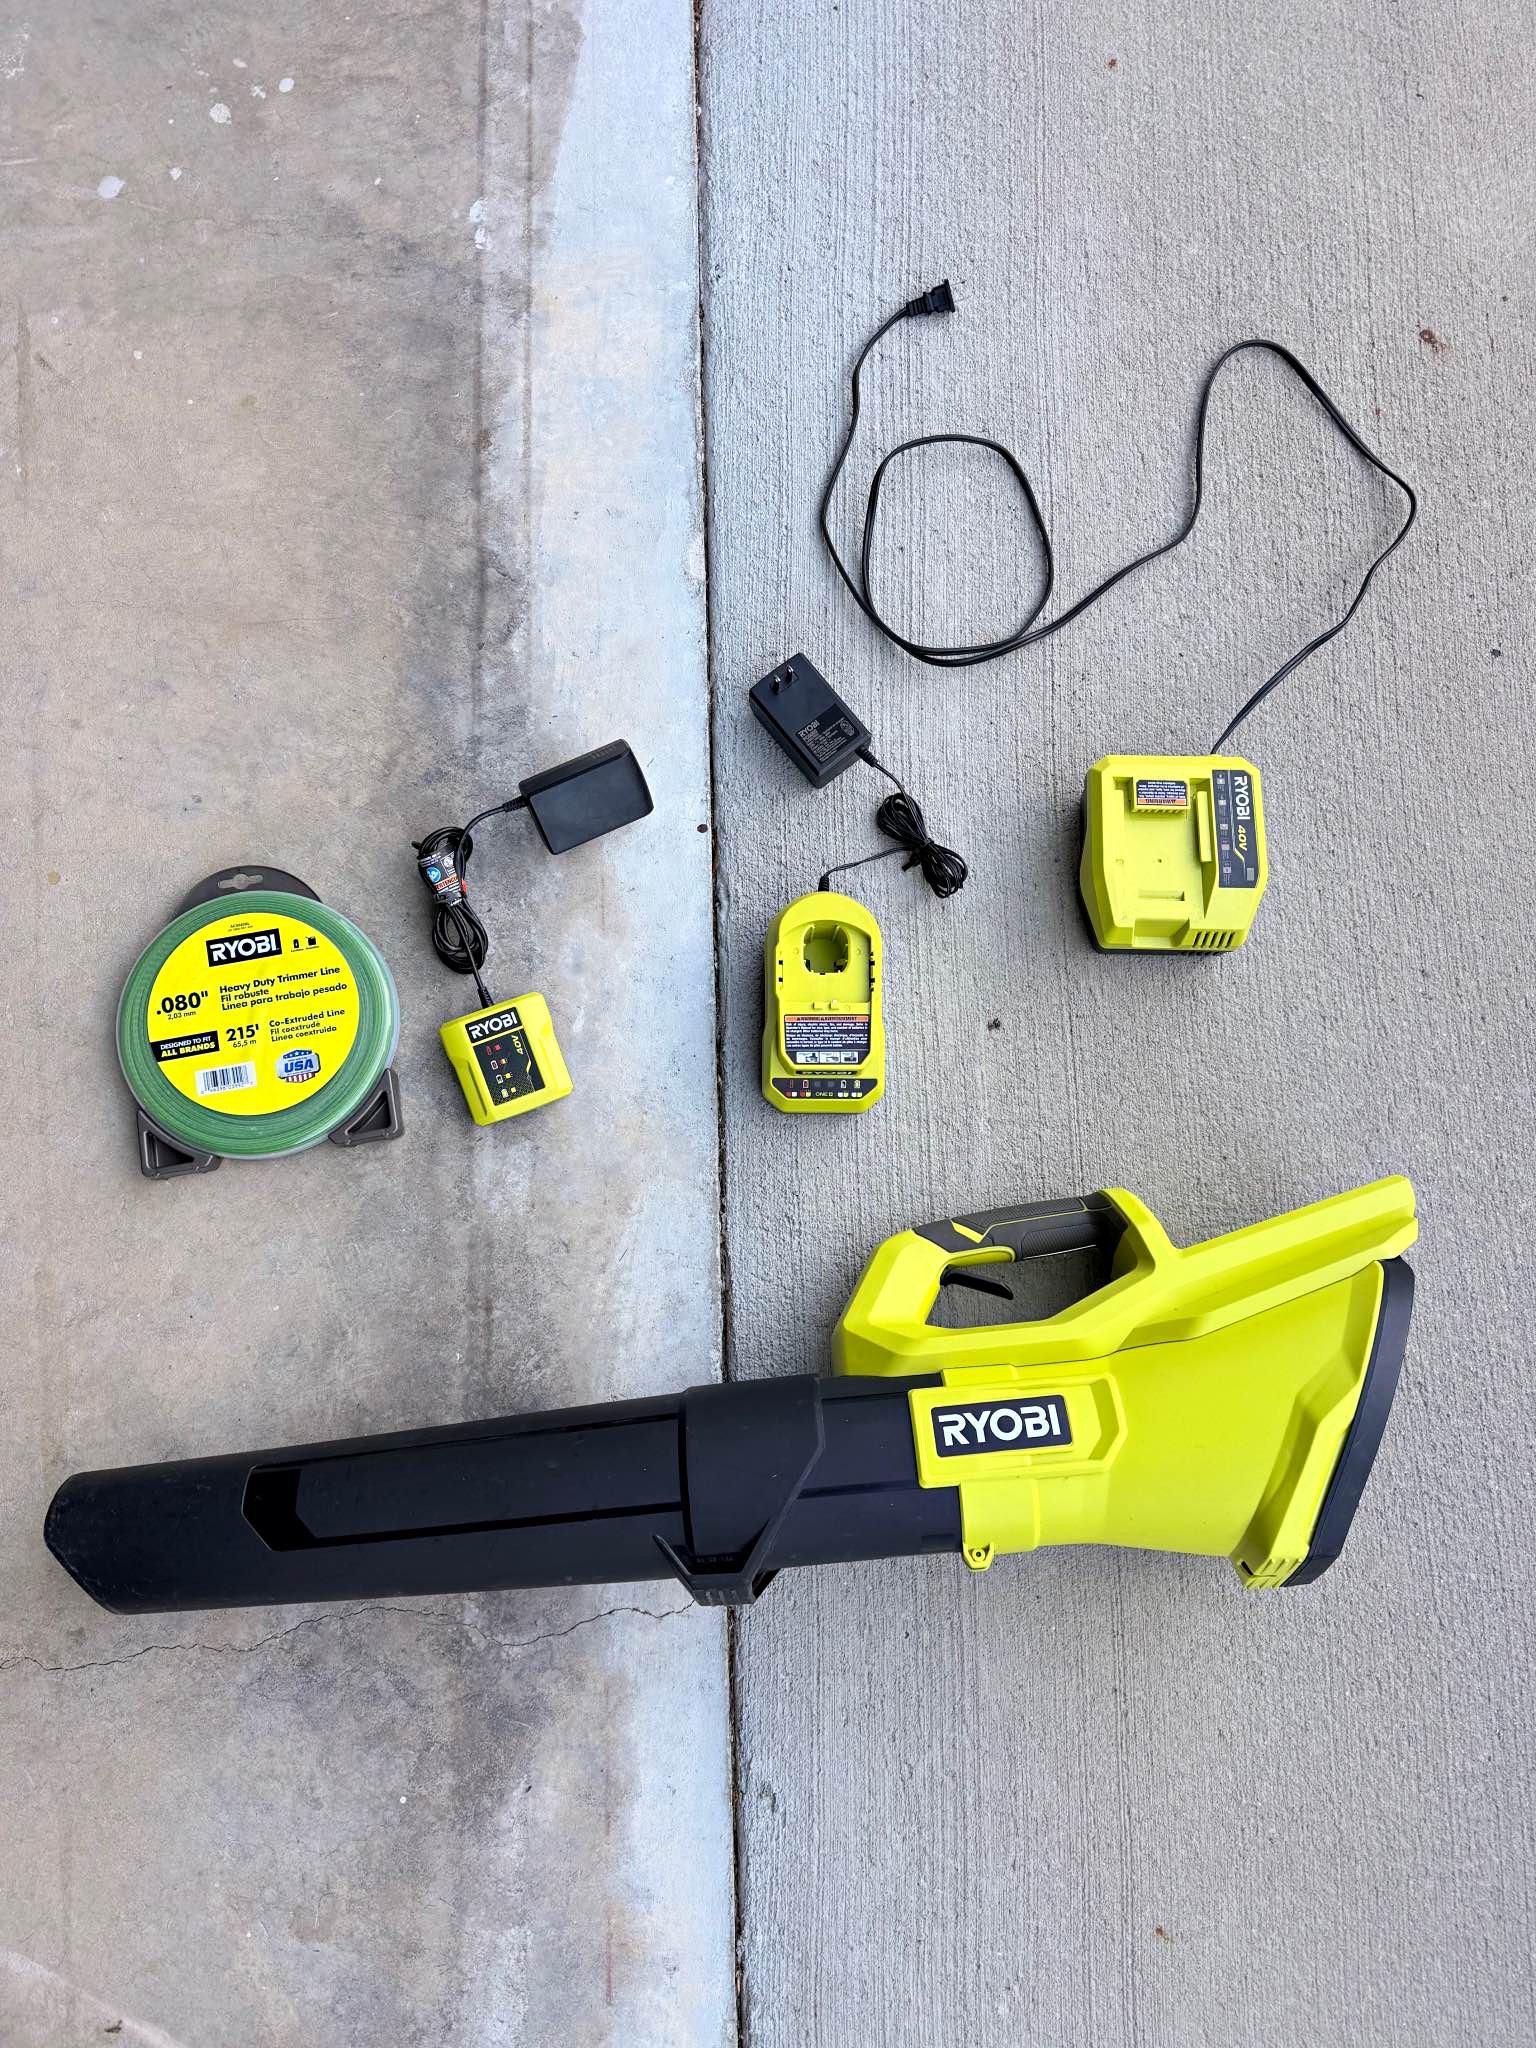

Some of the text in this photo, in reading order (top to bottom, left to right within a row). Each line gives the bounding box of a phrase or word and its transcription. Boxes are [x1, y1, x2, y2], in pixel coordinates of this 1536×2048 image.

[1234, 776, 1250, 851] RYOBI 40V
[209, 933, 277, 962] RYOBI
[219, 966, 341, 994] Heavy Duty Trimmer Line
[156, 990, 208, 1015] .080"
[220, 988, 270, 1002] Fil robuste
[250, 996, 273, 1007] para
[275, 989, 311, 1001] trabajo
[312, 982, 348, 996] pesado
[269, 1008, 345, 1027] Co-Extruded Line
[468, 1011, 518, 1039] RYOBI
[226, 1023, 259, 1041] 215'
[295, 1025, 337, 1038] coextruida
[160, 1040, 192, 1050] DESIGNED
[161, 1042, 216, 1058] ALL BRANDS
[511, 1035, 523, 1055] 40V
[284, 1058, 314, 1073] USA
[938, 1404, 1061, 1447] RYOBI
